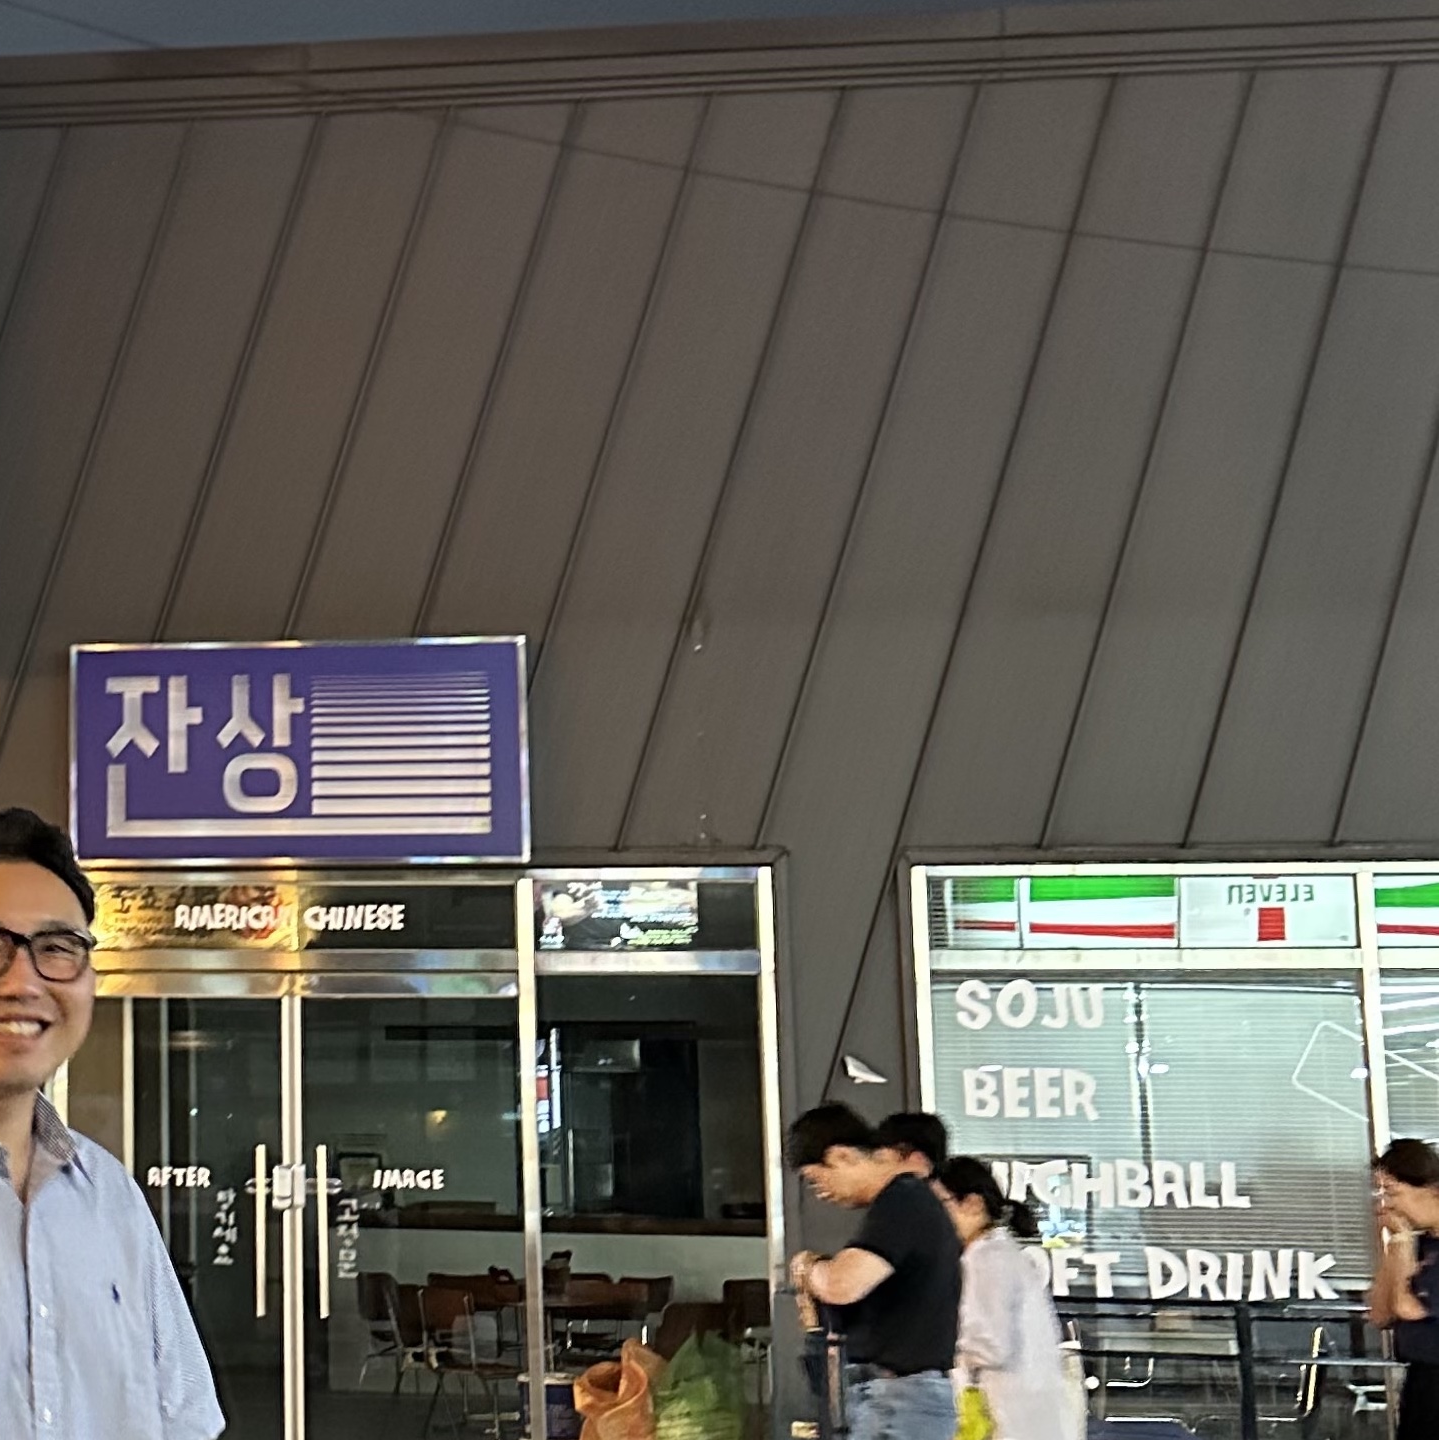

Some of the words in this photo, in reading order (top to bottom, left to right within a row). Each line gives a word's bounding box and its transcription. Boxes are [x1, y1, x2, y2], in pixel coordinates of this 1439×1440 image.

[303, 904, 406, 931] CHINESE
[956, 978, 1104, 1029] SOJU
[963, 1066, 1098, 1121] BEER
[147, 1165, 211, 1188] AFTER
[372, 1168, 445, 1190] IMAGE
[1022, 1245, 1121, 1299] OFT
[1144, 1247, 1340, 1300] DRINK
